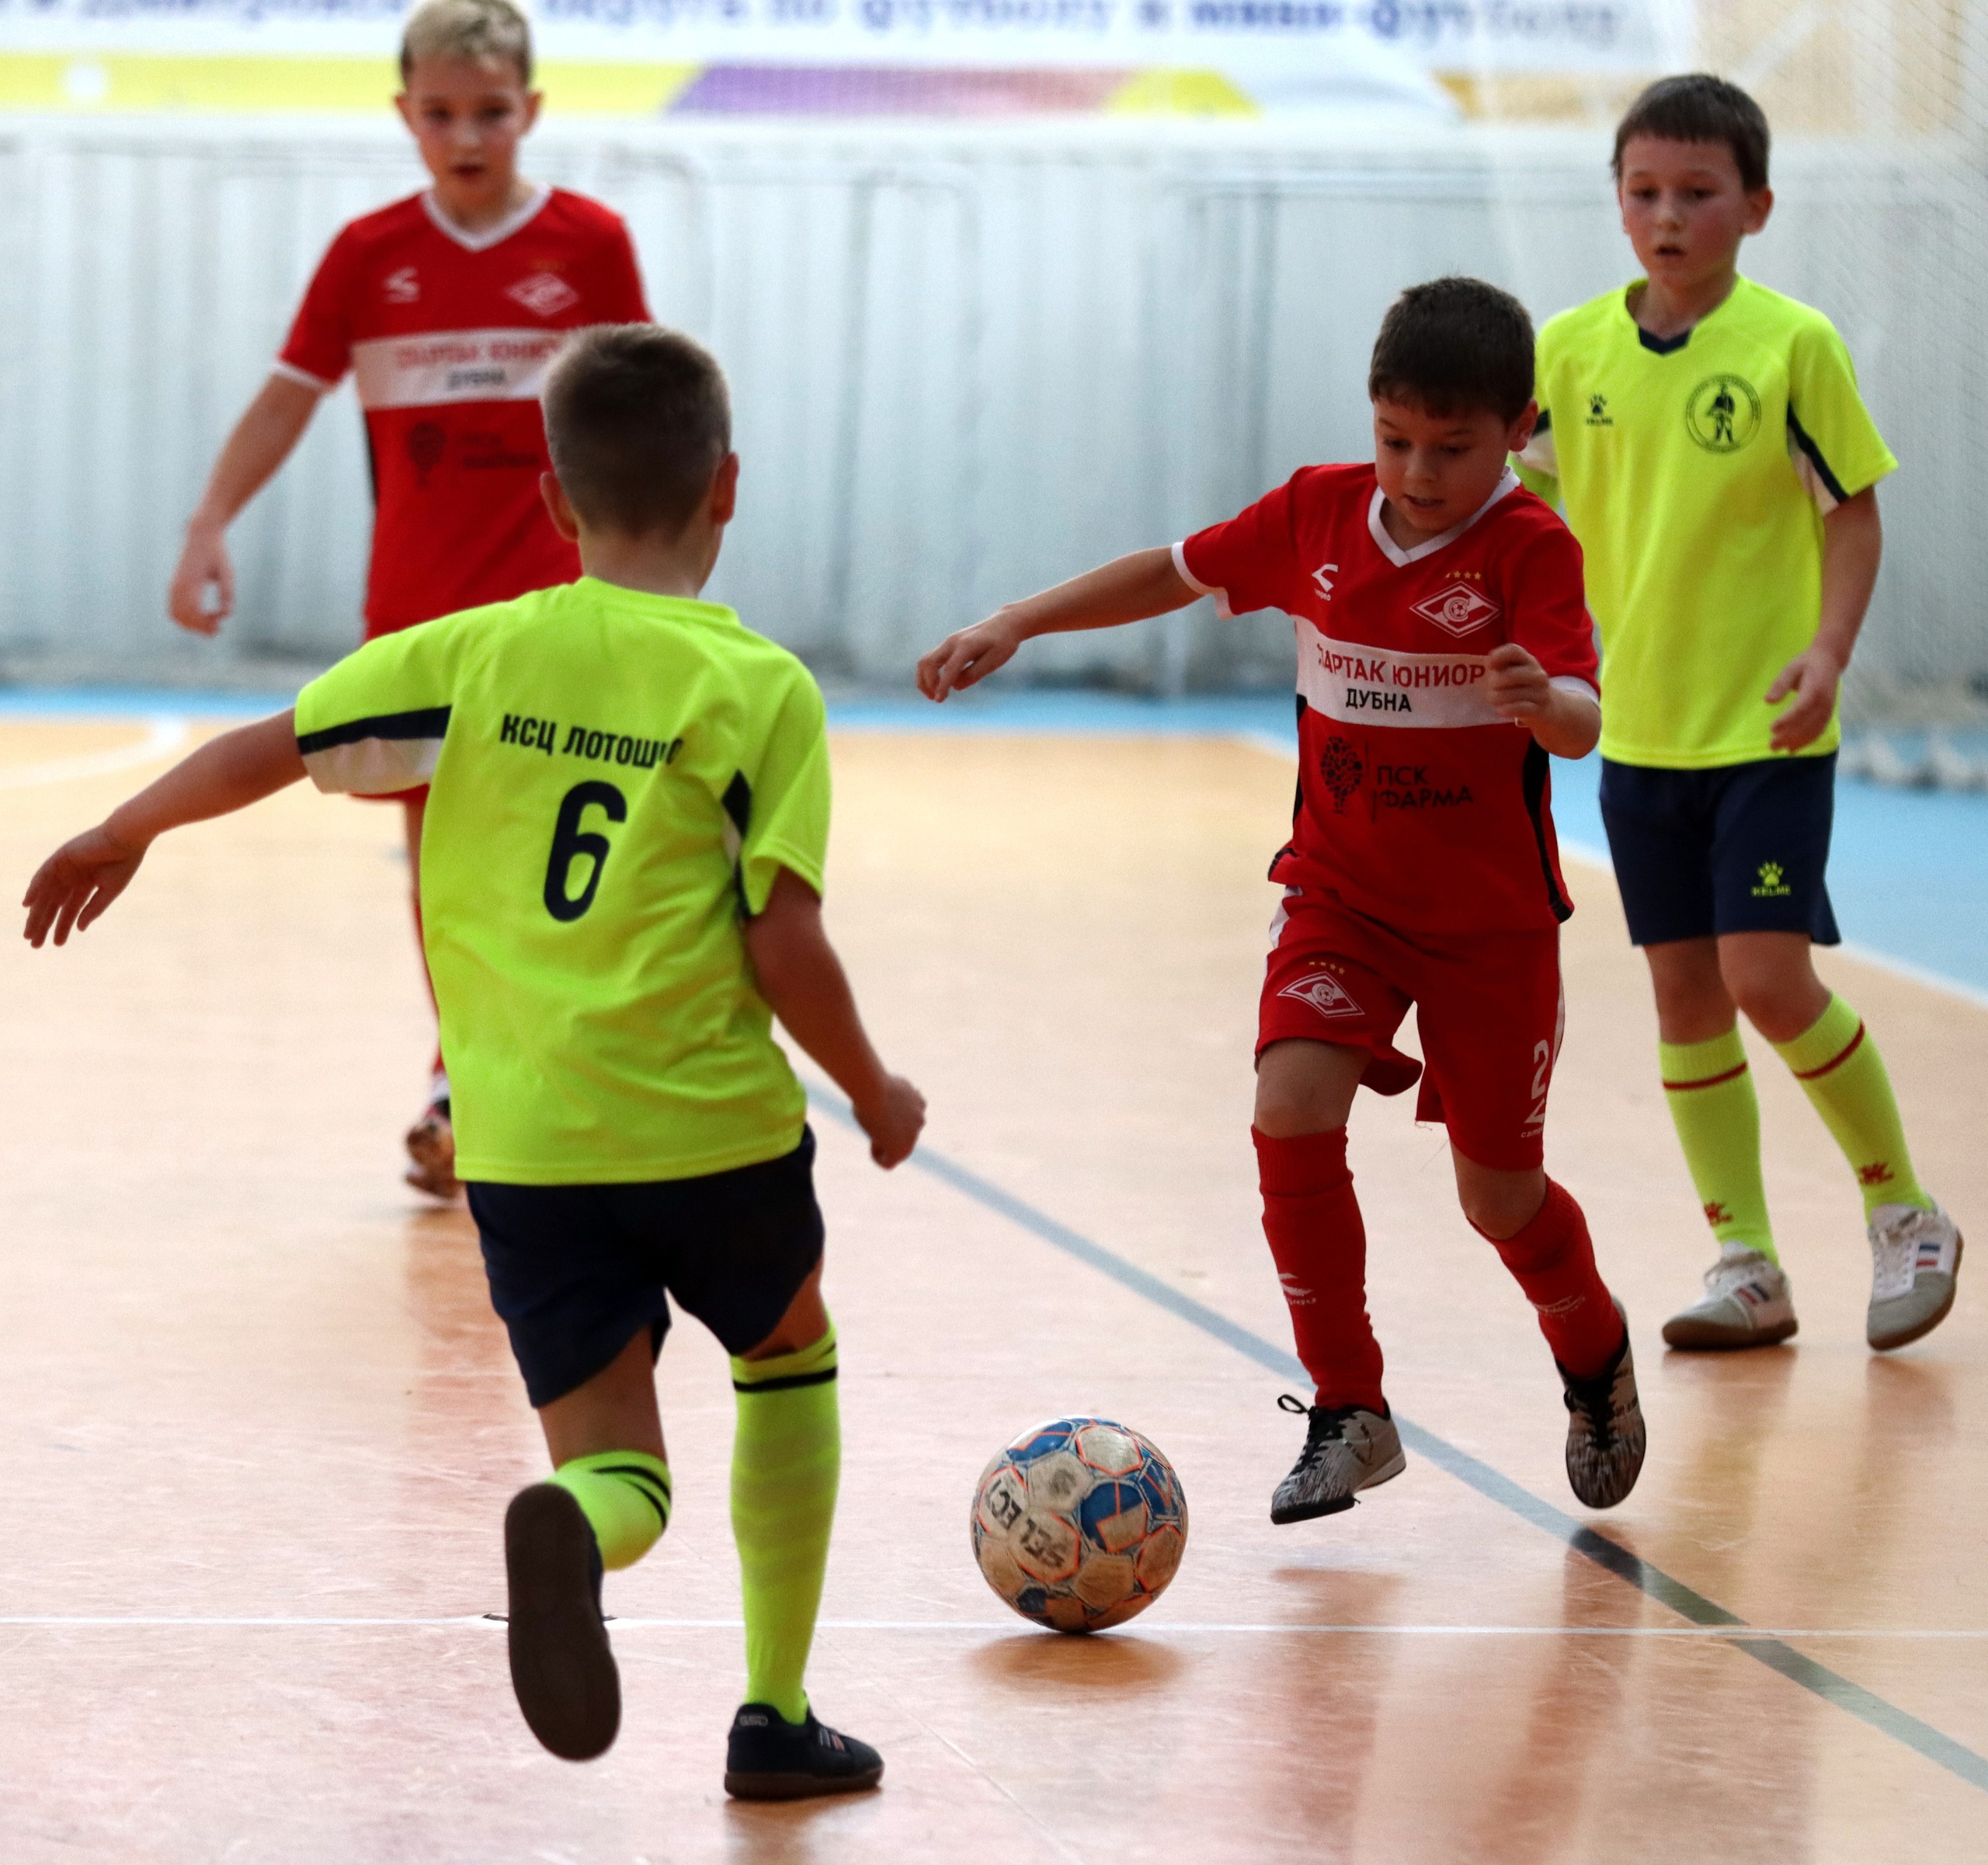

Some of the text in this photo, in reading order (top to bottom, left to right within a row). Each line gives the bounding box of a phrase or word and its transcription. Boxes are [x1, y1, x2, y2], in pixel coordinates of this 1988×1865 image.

[1392, 663, 1486, 688] ЮНИОР
[1345, 687, 1413, 713] ДУБНА
[500, 712, 557, 756] КСЦ
[1377, 764, 1429, 786] ПСК
[1379, 785, 1475, 810] ФАРМА
[543, 779, 628, 923] 6
[1531, 1039, 1549, 1101] 2
